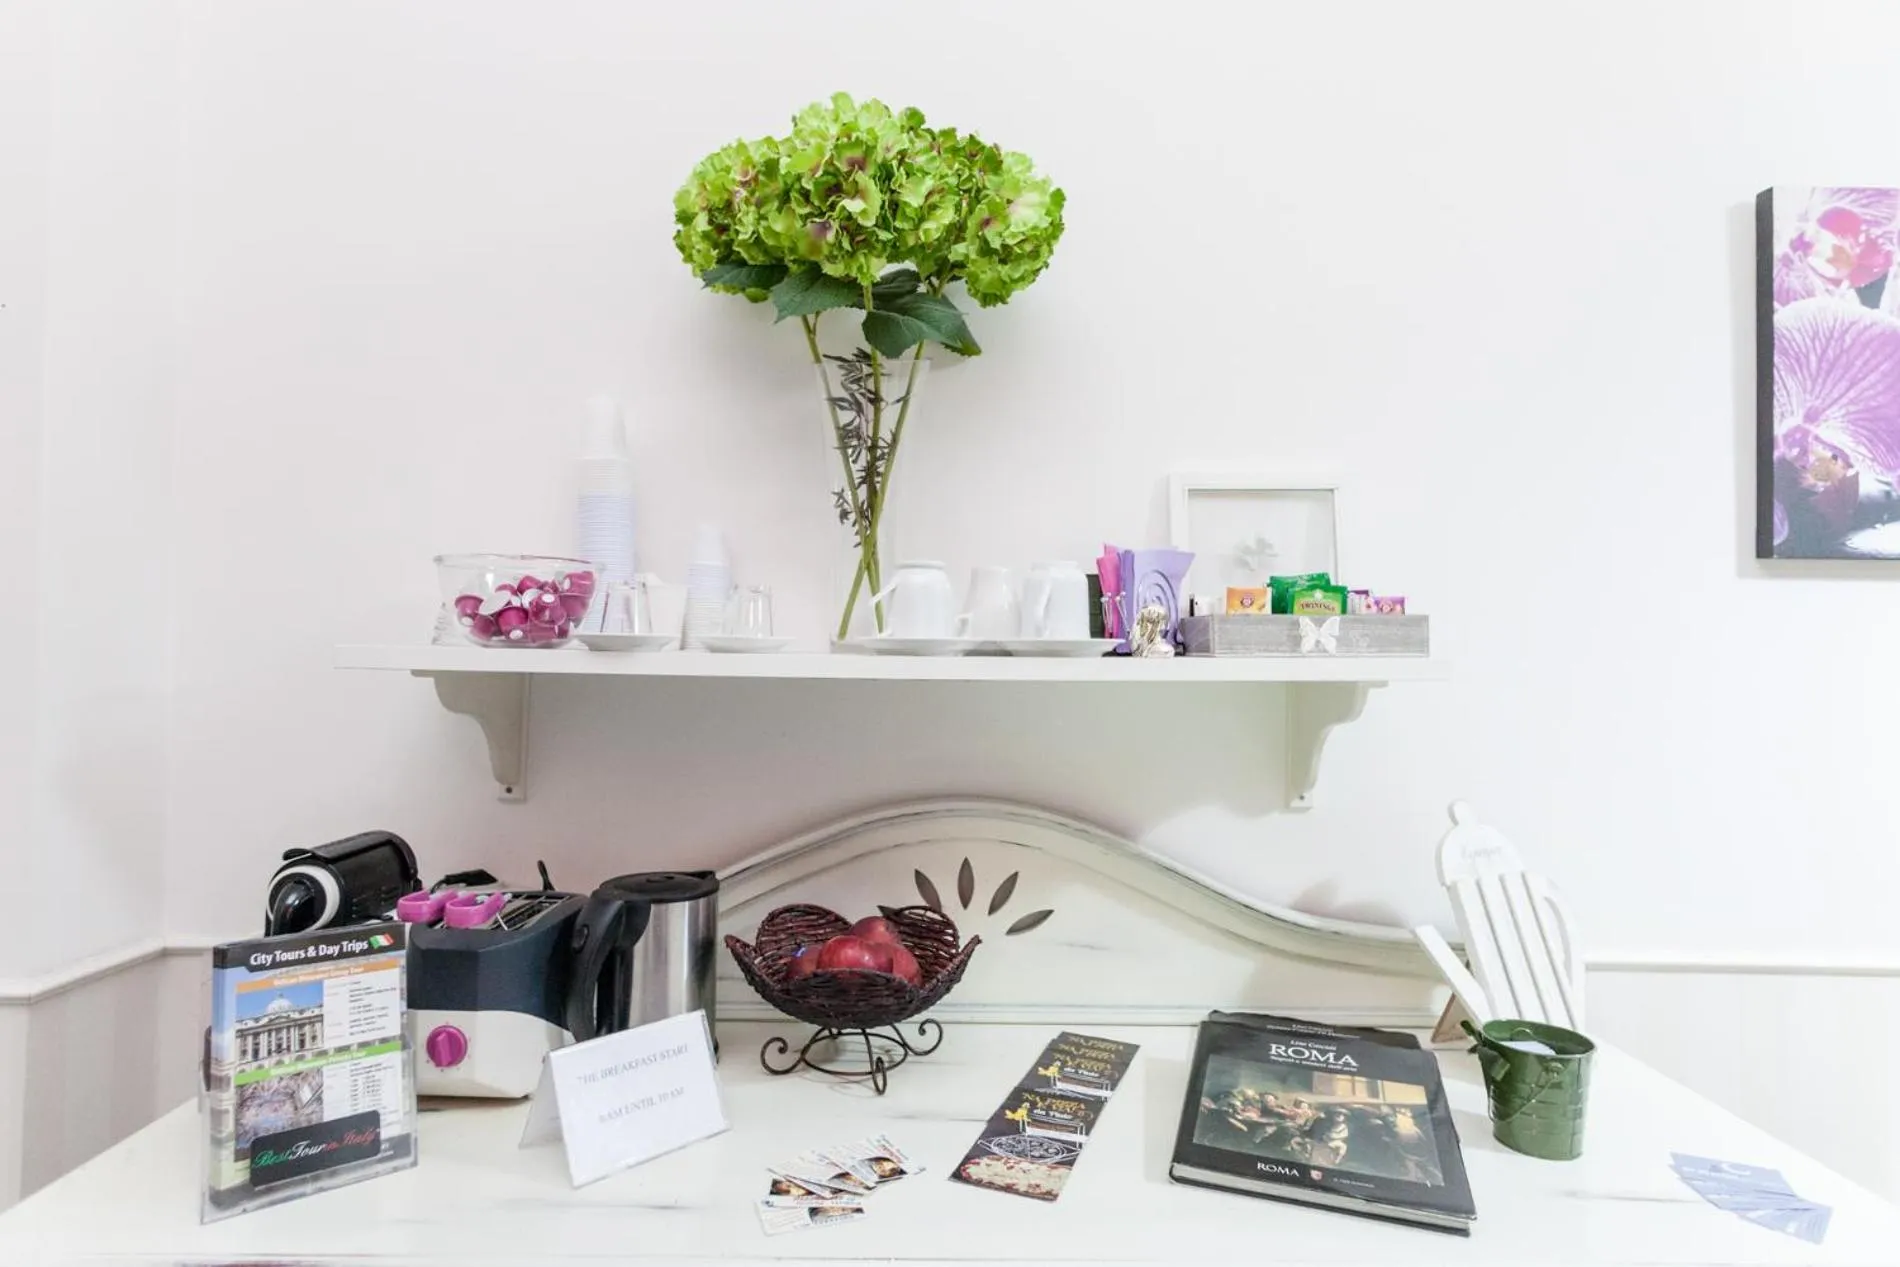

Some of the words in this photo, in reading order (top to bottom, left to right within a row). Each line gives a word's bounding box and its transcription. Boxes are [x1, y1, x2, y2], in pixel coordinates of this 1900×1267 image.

[250, 952, 273, 967] City
[275, 949, 305, 961] Tours
[307, 946, 316, 957] &
[319, 943, 340, 957] Day
[342, 939, 368, 953] Trips
[577, 1071, 600, 1085] THE
[601, 1053, 658, 1080] BREAKFAST
[660, 1043, 688, 1062] START
[1268, 1043, 1360, 1067] ROMA
[624, 1097, 657, 1115] UNTIL
[1257, 1161, 1300, 1177] ROMA
